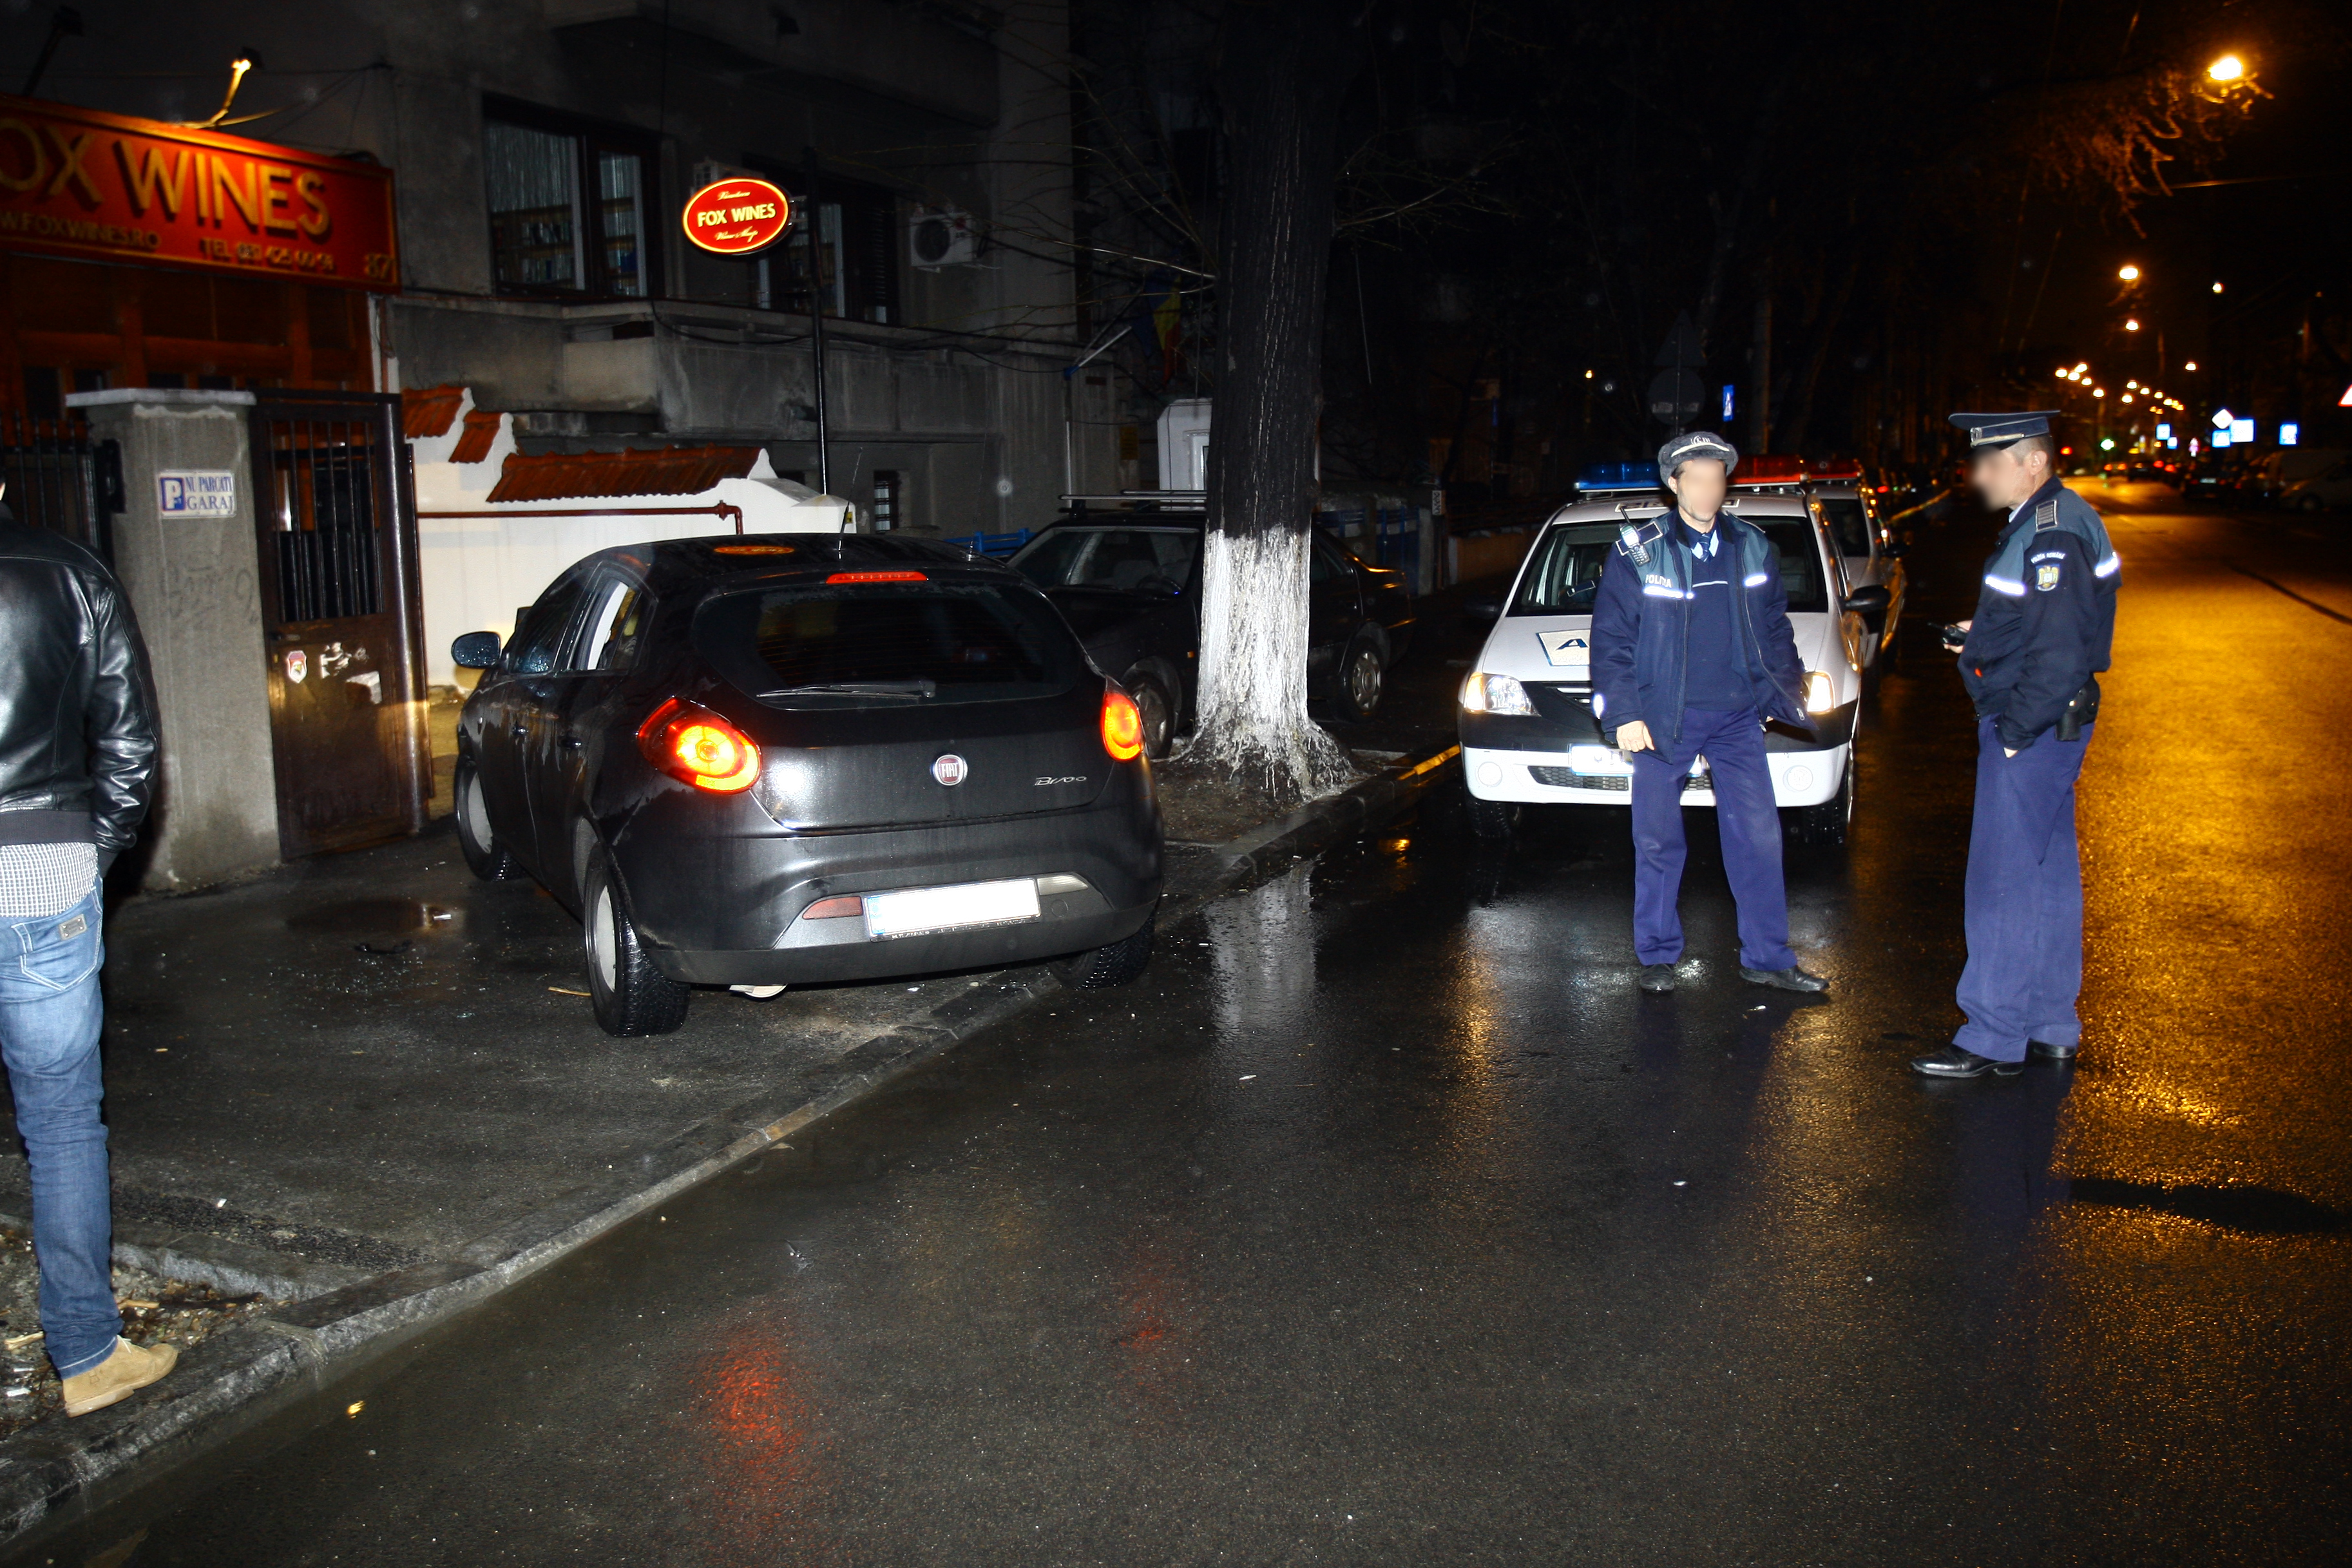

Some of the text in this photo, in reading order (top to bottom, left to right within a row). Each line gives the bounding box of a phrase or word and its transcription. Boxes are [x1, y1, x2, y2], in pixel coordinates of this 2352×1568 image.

[120, 139, 330, 236] WINES
[697, 203, 776, 227] FOX WINES
[165, 480, 182, 509] P
[185, 477, 195, 492] NU
[187, 495, 233, 514] GARAJ
[941, 762, 958, 778] FIAT
